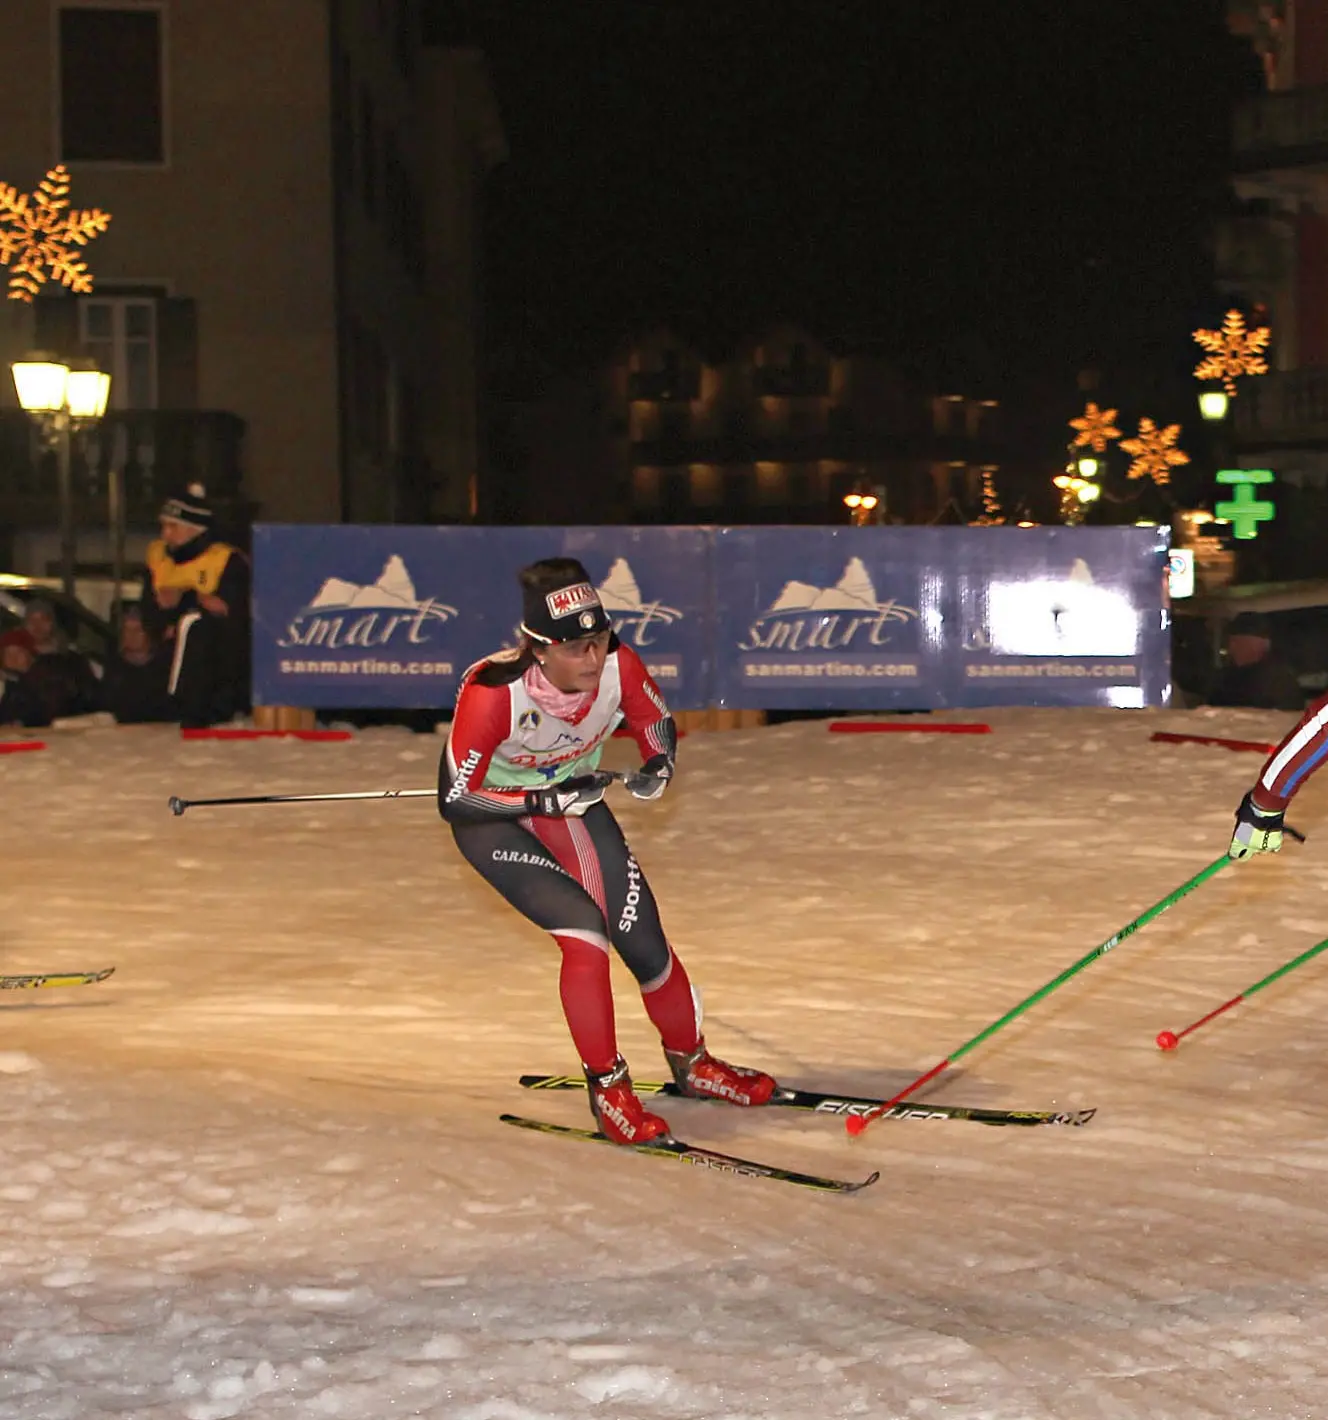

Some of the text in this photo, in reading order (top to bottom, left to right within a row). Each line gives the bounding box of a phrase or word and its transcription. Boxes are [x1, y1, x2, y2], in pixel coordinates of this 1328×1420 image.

[277, 598, 438, 649] smart
[737, 600, 895, 652] smart
[281, 659, 453, 676] sanmartino.com
[745, 661, 917, 678] sanmartino.com
[966, 664, 1136, 678] sanmartino.com
[445, 749, 483, 804] portful
